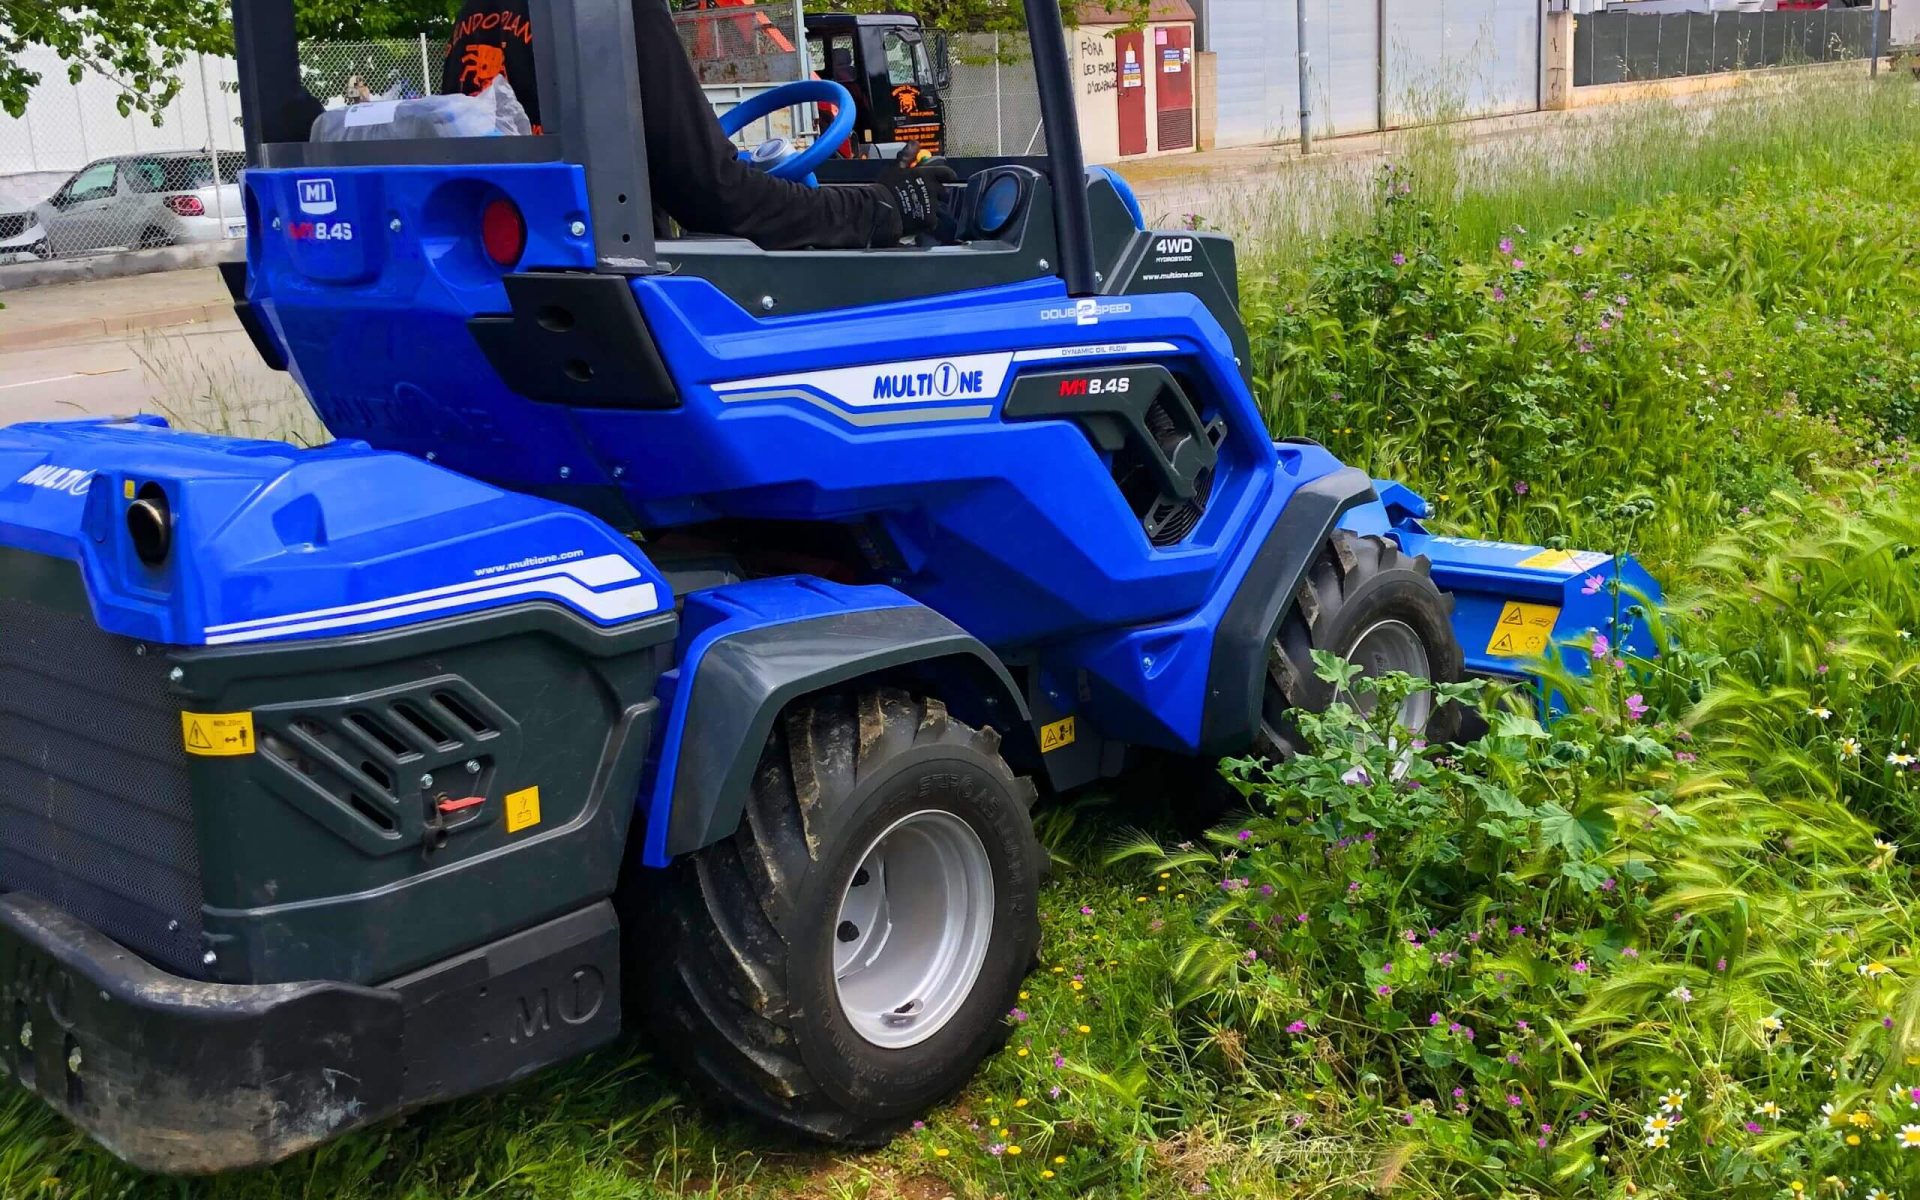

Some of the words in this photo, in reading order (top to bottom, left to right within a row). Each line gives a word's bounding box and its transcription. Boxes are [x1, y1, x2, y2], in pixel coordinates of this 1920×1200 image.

[1156, 238, 1193, 254] 4WD
[1155, 255, 1193, 263] HYDROSTATIC
[1142, 270, 1204, 281] www.multione.com
[1062, 347, 1095, 356] DYNAMIC
[1095, 346, 1107, 354] OIL
[1108, 345, 1128, 353] FLOW
[1088, 377, 1130, 394] 8.4S
[474, 549, 584, 577] www.multione.com
